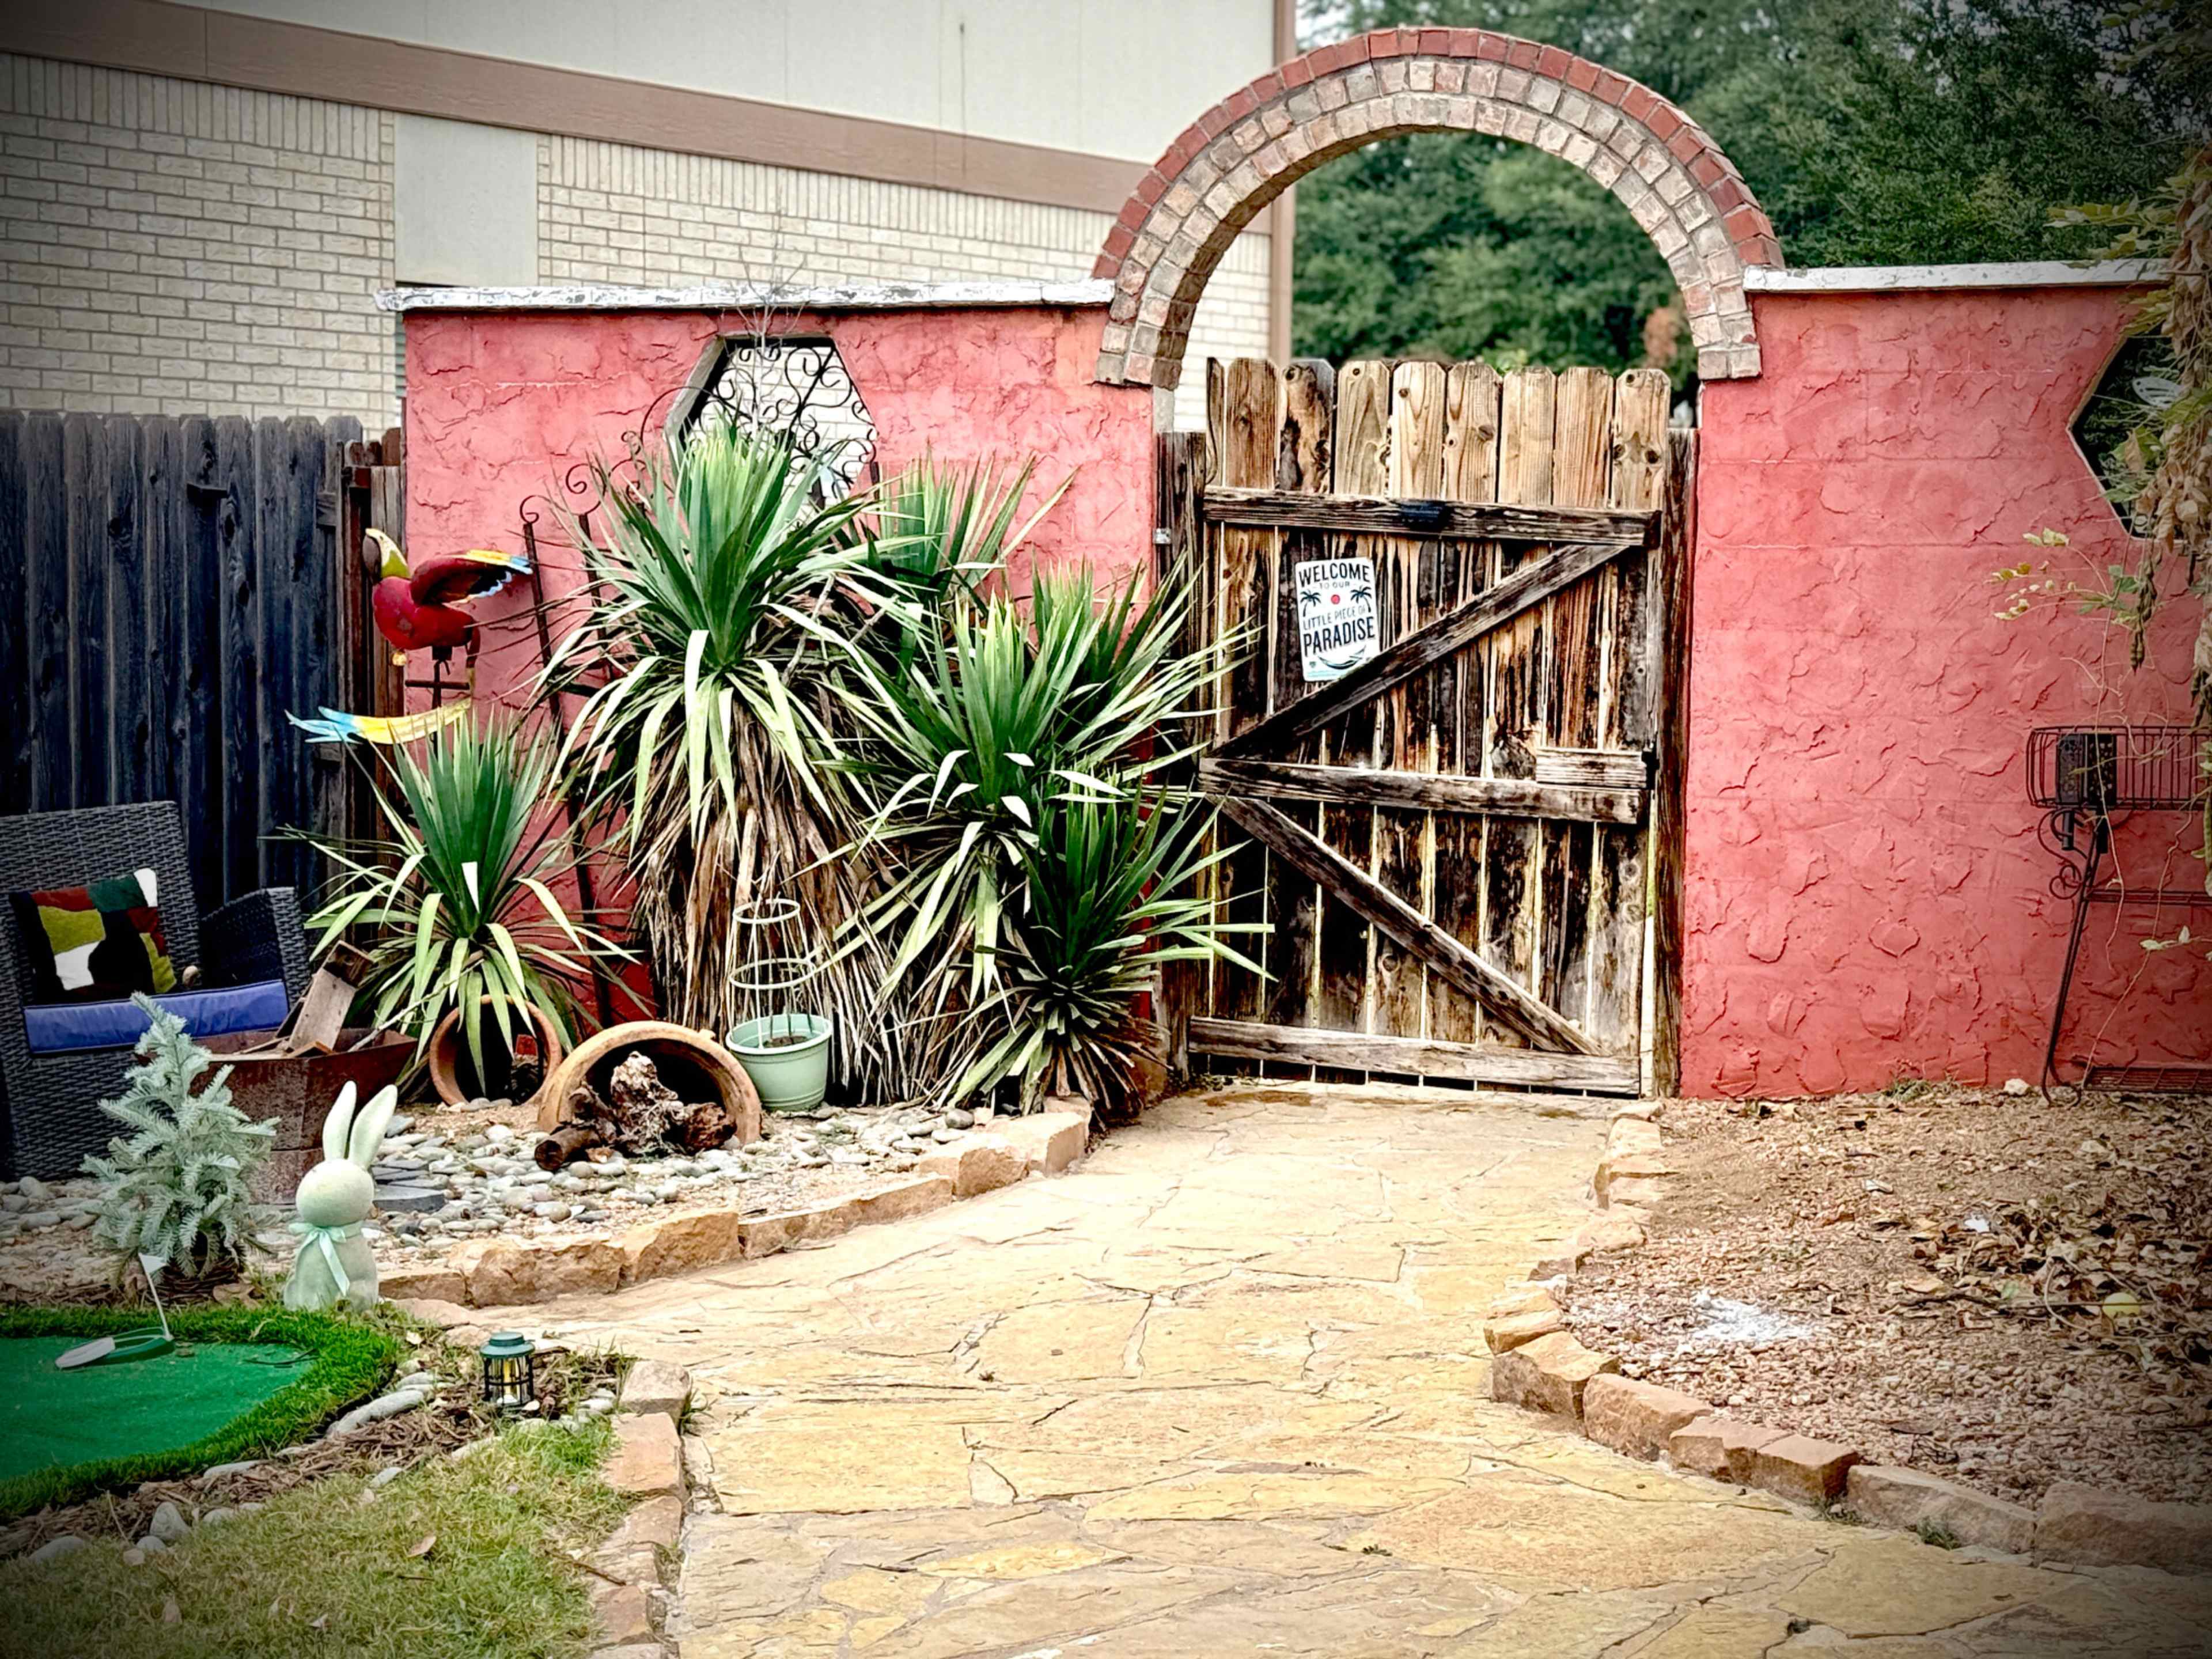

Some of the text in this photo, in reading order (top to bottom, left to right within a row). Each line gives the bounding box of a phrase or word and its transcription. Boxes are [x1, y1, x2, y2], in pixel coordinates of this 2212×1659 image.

[1299, 562, 1370, 587] WELCOME
[1302, 612, 1332, 630] LITTLE
[1335, 605, 1356, 620] PIECE
[1303, 616, 1376, 657] PARADISE
